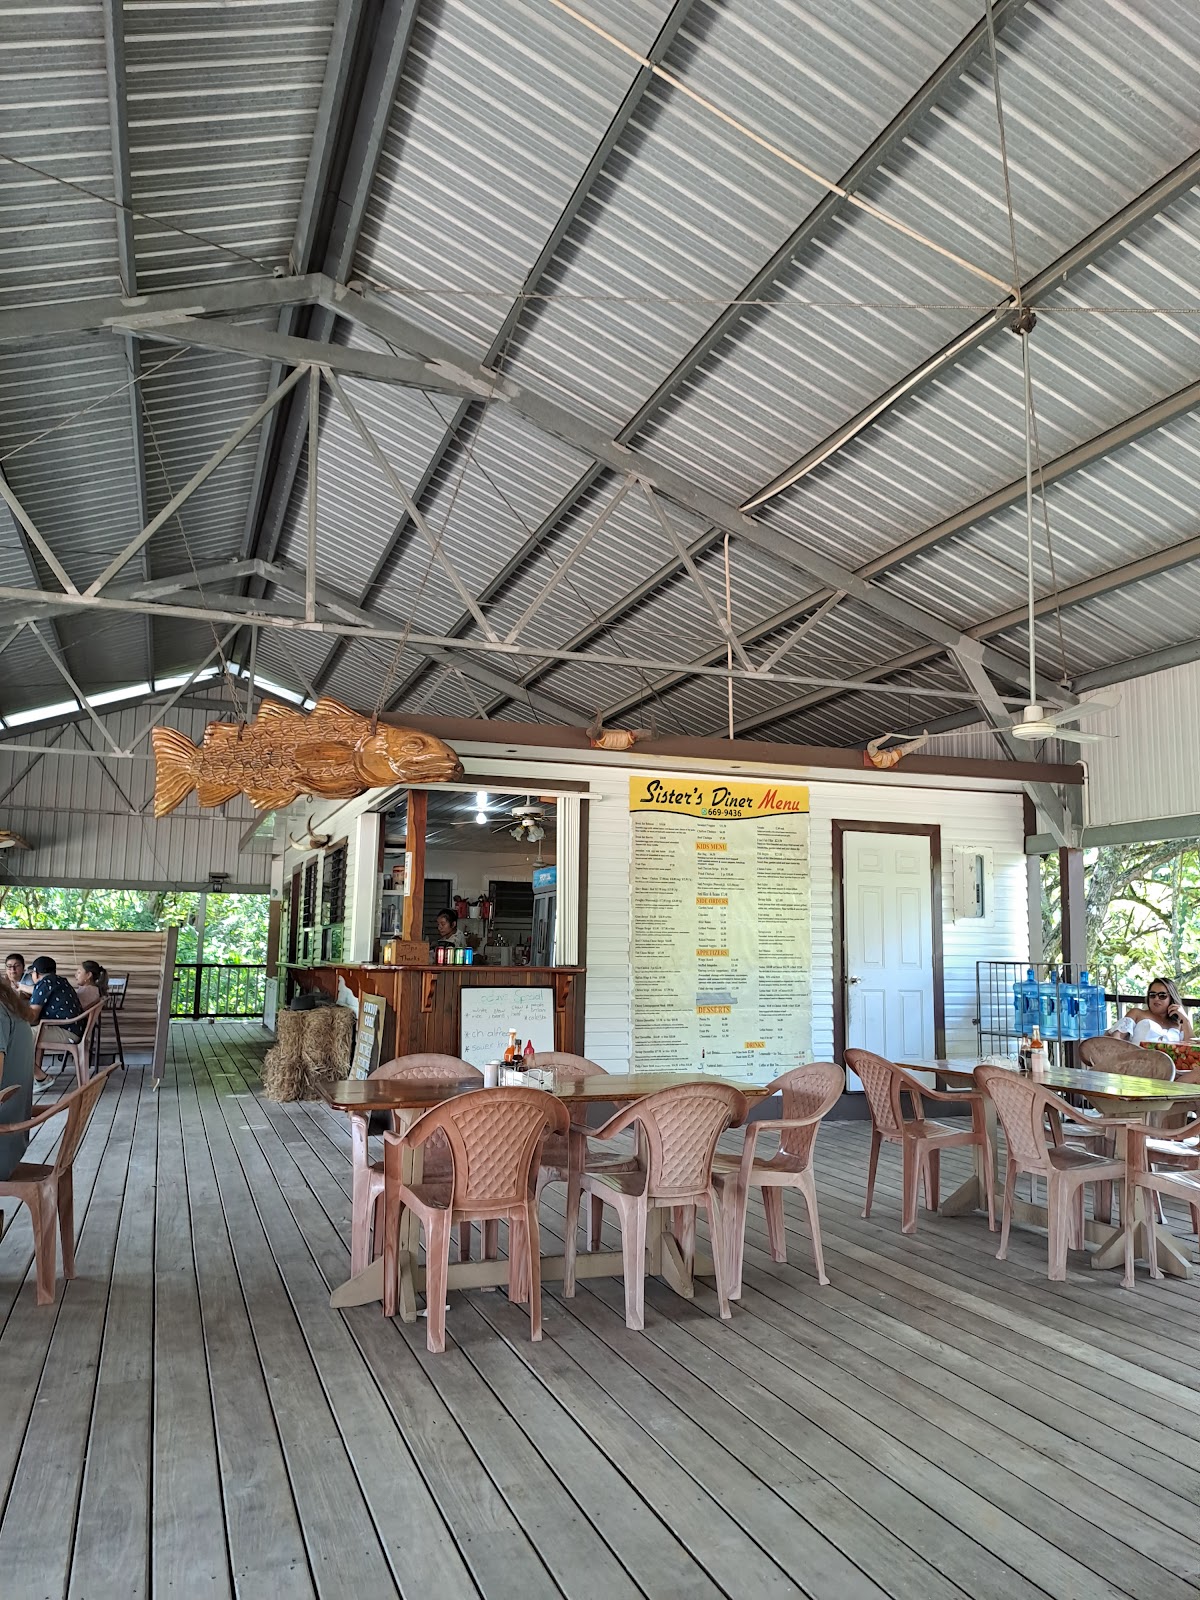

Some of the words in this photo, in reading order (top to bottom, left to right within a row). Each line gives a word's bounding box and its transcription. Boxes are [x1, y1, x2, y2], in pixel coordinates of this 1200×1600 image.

[640, 780, 703, 806] Sister's
[712, 787, 753, 808] Diner
[757, 788, 800, 811] Menu
[708, 808, 742, 817] 669-9436
